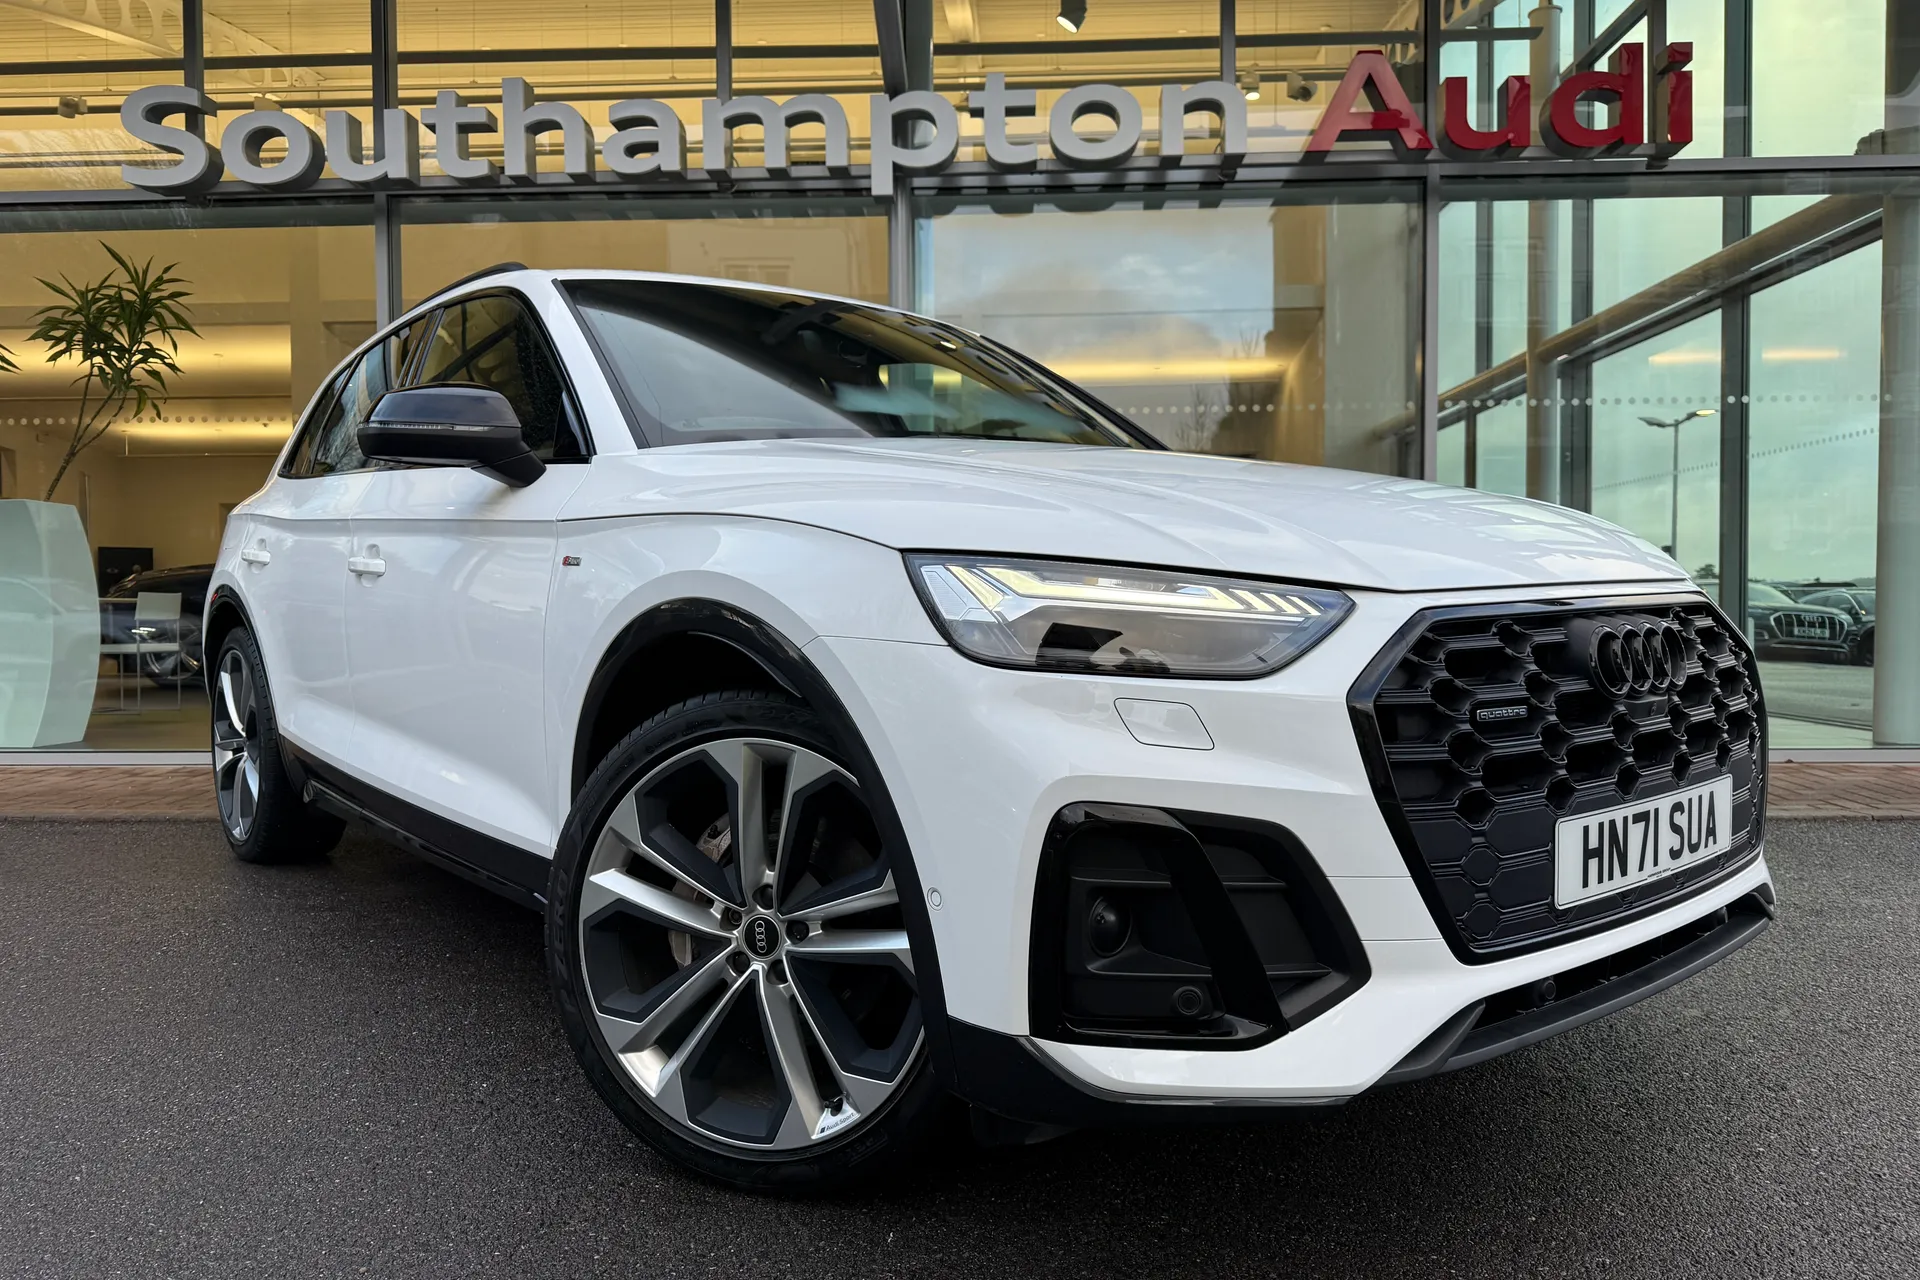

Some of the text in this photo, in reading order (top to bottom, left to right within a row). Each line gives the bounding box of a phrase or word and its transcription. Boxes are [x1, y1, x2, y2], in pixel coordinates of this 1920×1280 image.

[120, 42, 1694, 197] Southampton Audi
[1480, 708, 1527, 720] quattro
[1582, 790, 1717, 889] HN71 SUA
[826, 1112, 855, 1131] Audi Sport
